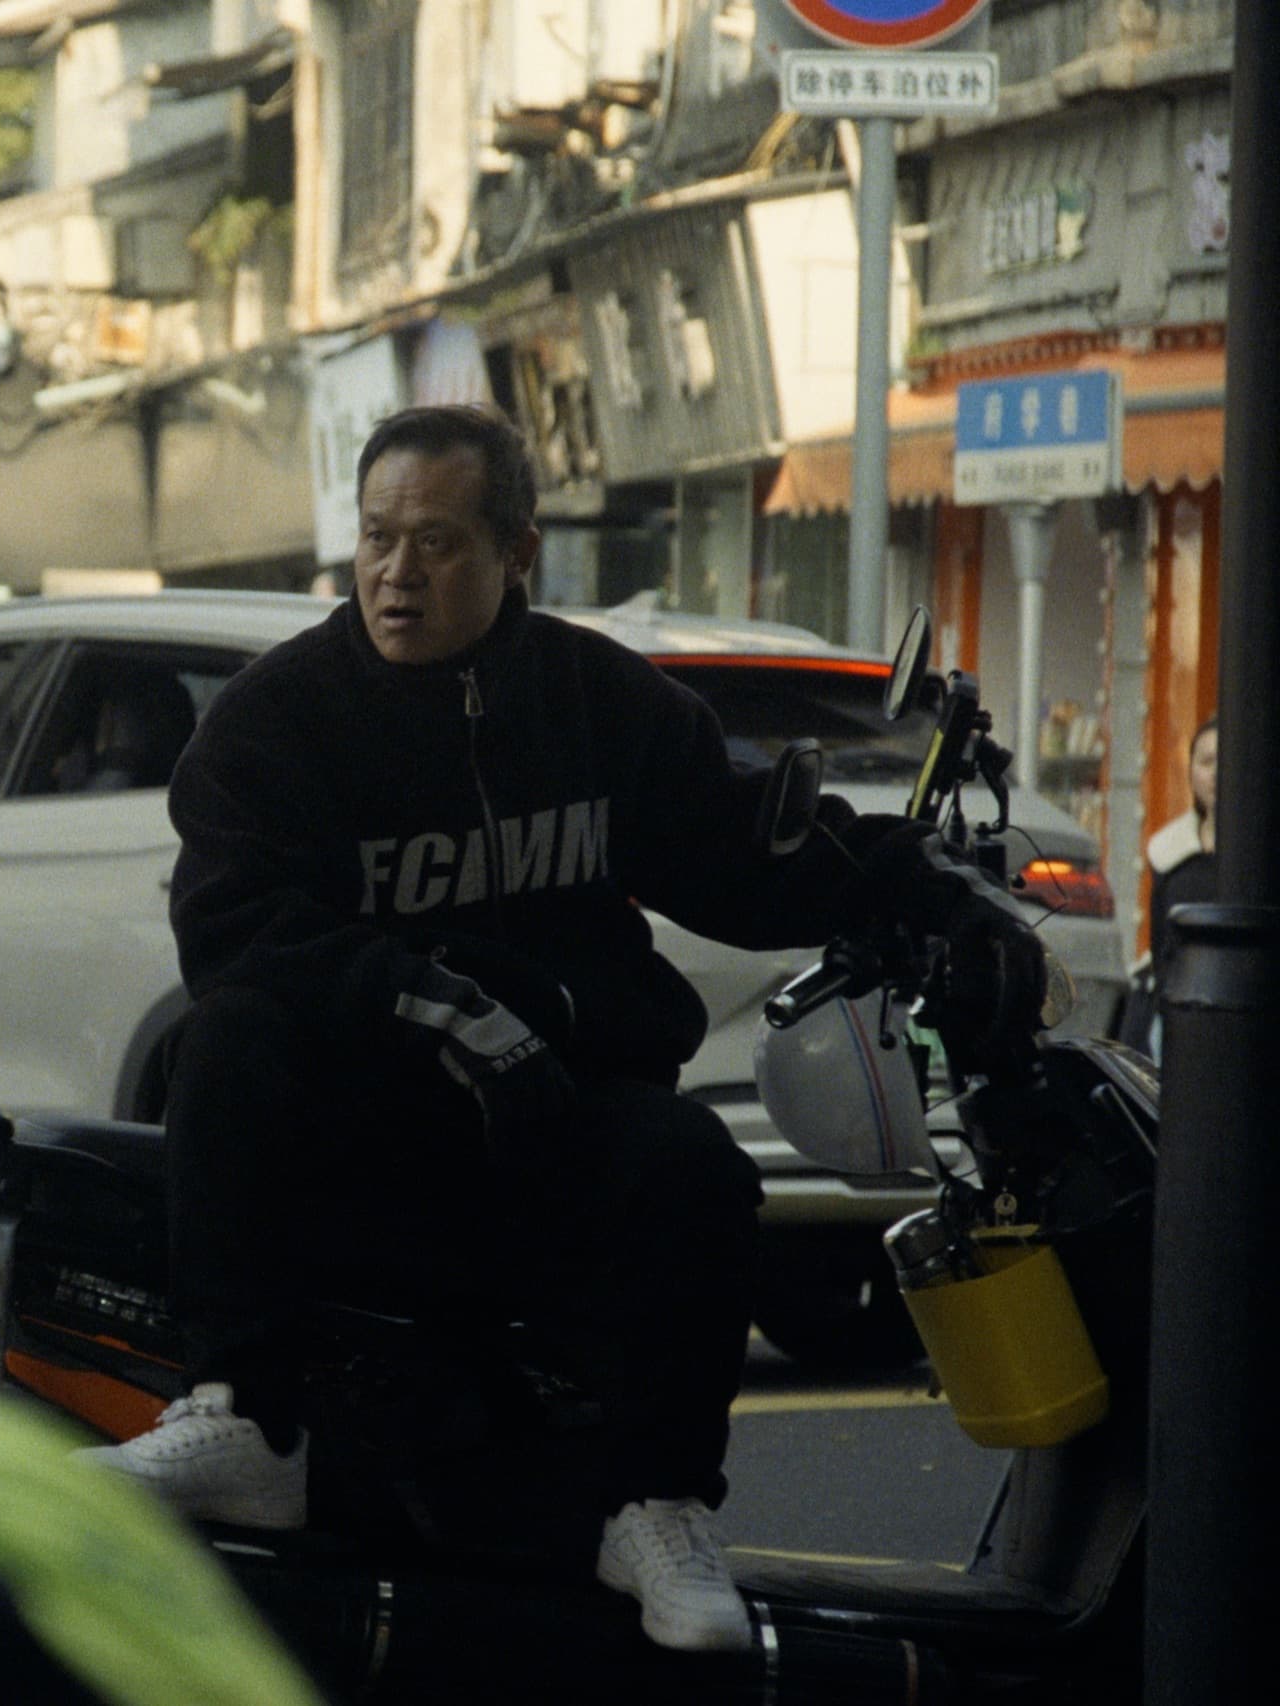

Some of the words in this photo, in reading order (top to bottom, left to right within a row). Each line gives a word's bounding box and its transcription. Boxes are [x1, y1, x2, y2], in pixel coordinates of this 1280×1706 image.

[796, 67, 983, 98] 除停车泊位外
